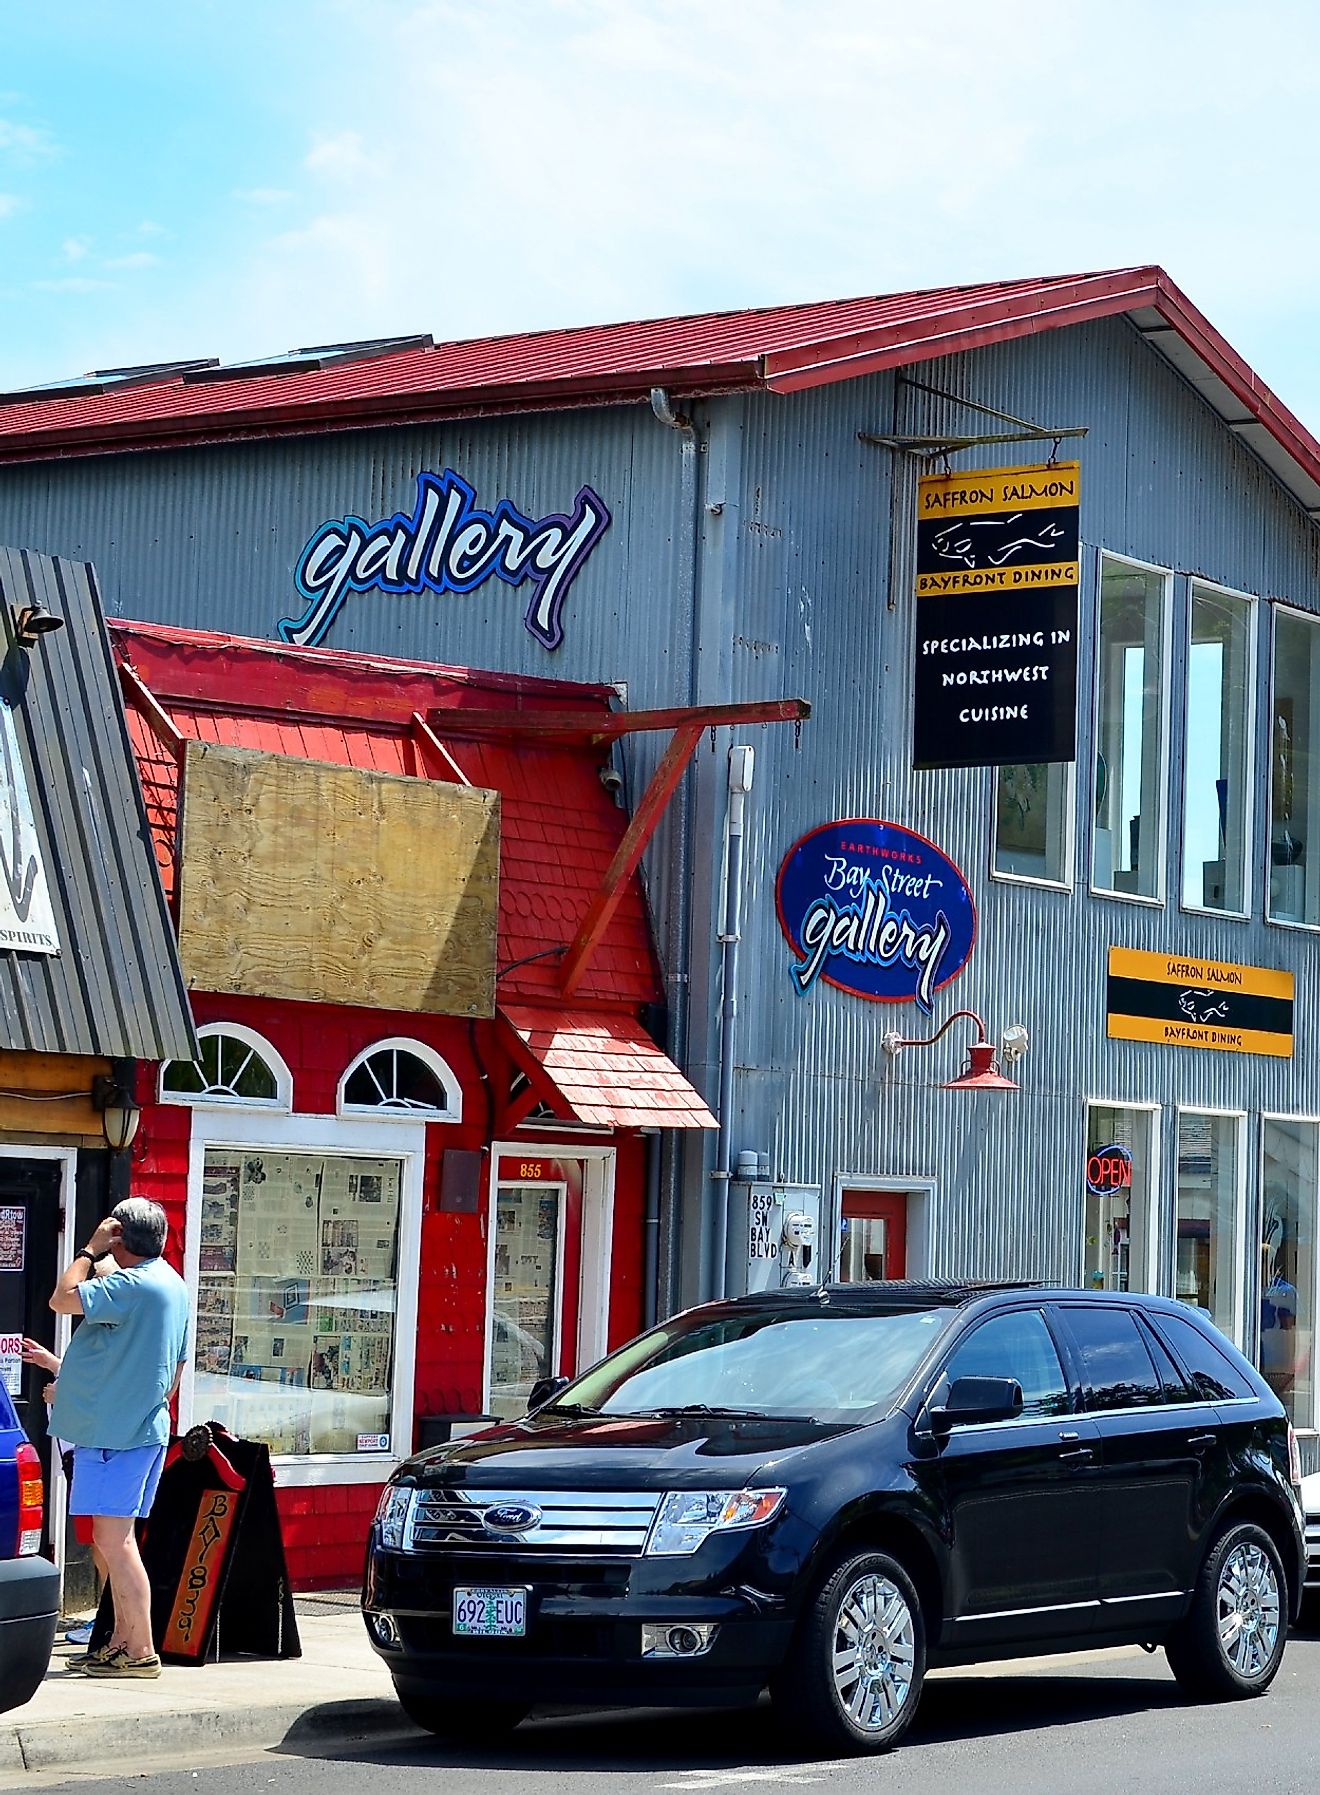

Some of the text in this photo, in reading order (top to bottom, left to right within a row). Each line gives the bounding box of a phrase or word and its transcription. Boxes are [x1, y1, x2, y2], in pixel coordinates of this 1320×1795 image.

[924, 480, 1074, 510] SAFFRON SALMON
[286, 482, 600, 648] gallery
[919, 567, 1074, 591] BAYFRONT DINING
[922, 629, 1071, 655] SPECIALIZING IN
[942, 665, 1049, 687] NORTHWEST
[959, 704, 1029, 723] CUISINE
[840, 841, 923, 865] EARTHWORKS
[823, 854, 943, 899] Bay Street
[0, 929, 53, 947] SPIRITS
[798, 886, 948, 1005] gallery
[1166, 961, 1242, 985] SAFFRON SALMON
[1164, 1026, 1242, 1046] BAYFRONT DINING
[520, 1163, 542, 1178] 855
[1087, 1156, 1132, 1187] OPEN
[752, 1195, 773, 1211] 859
[755, 1211, 769, 1226] SW
[750, 1227, 771, 1243] BAY
[750, 1243, 778, 1259] BLVD
[496, 1507, 523, 1523] Ford
[457, 1600, 523, 1625] 692 EUC
